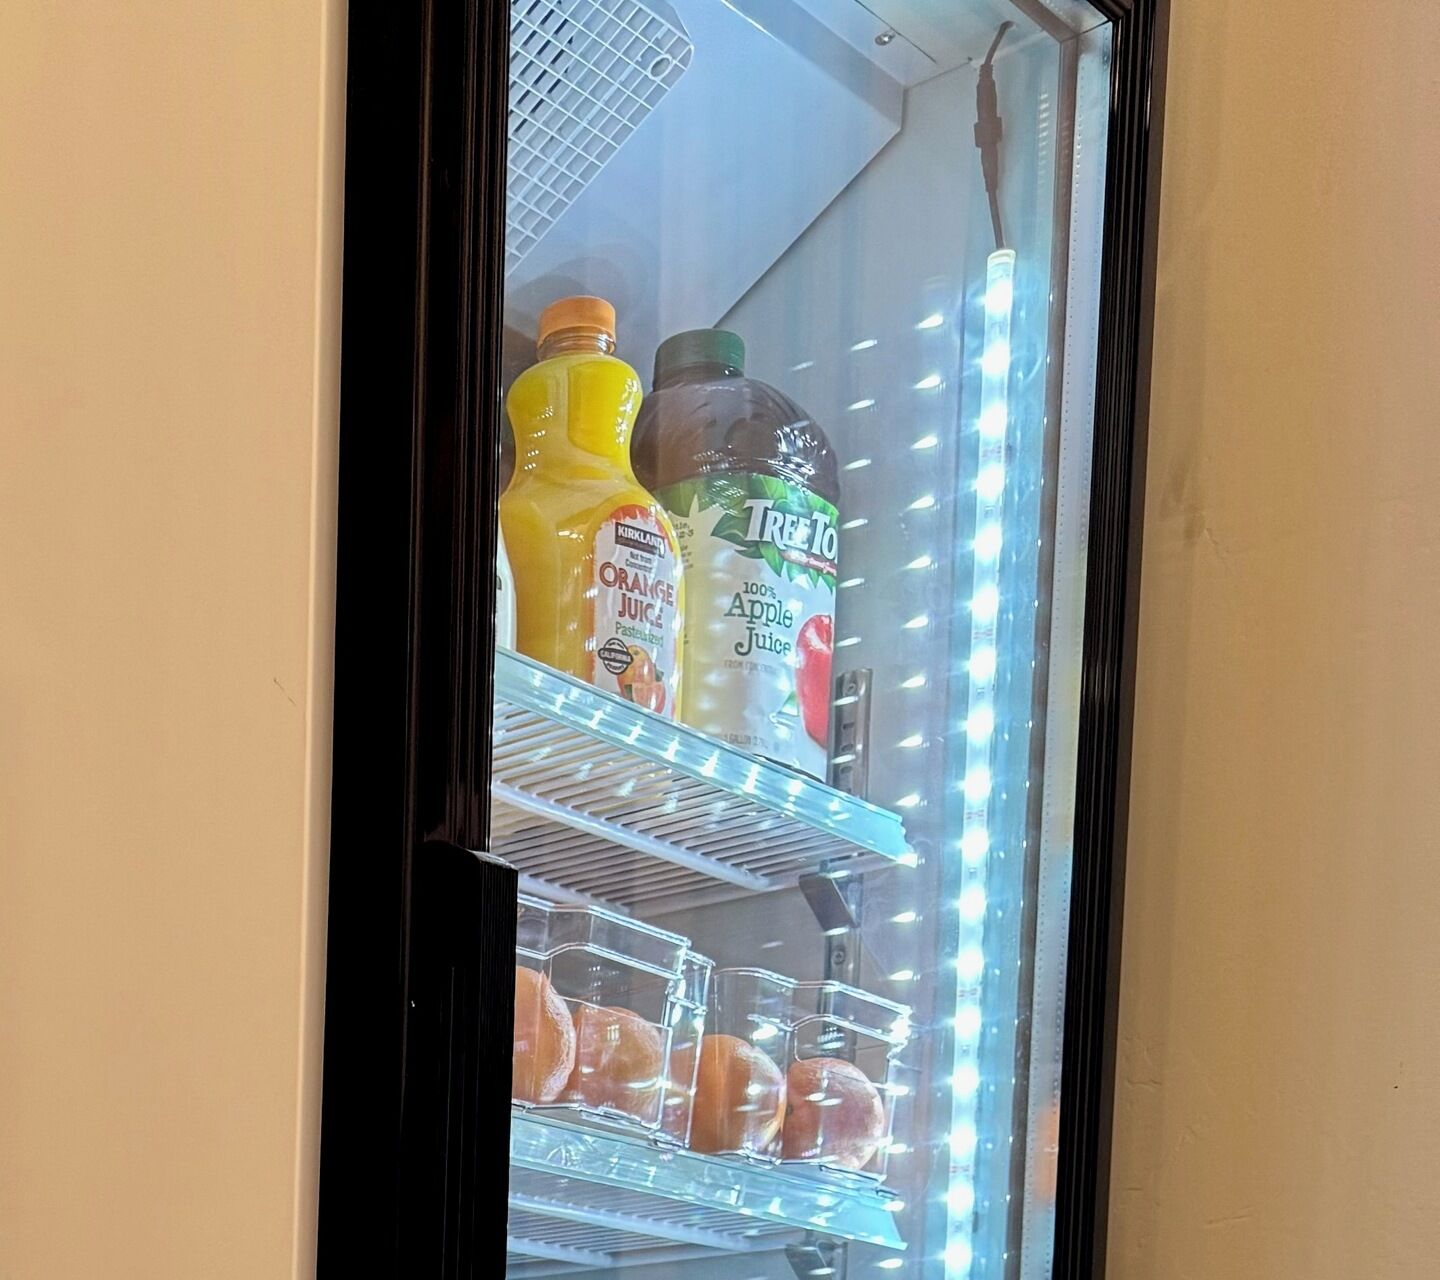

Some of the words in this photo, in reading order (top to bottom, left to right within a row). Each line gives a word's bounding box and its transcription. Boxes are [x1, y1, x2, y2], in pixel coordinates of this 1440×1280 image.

[617, 524, 665, 550] KIRKLAND
[811, 511, 839, 563] TO
[599, 561, 674, 607] ORANGE
[743, 581, 777, 600] 100%
[618, 593, 663, 630] JUICE
[724, 591, 793, 629] Apple
[734, 626, 791, 656] Juice
